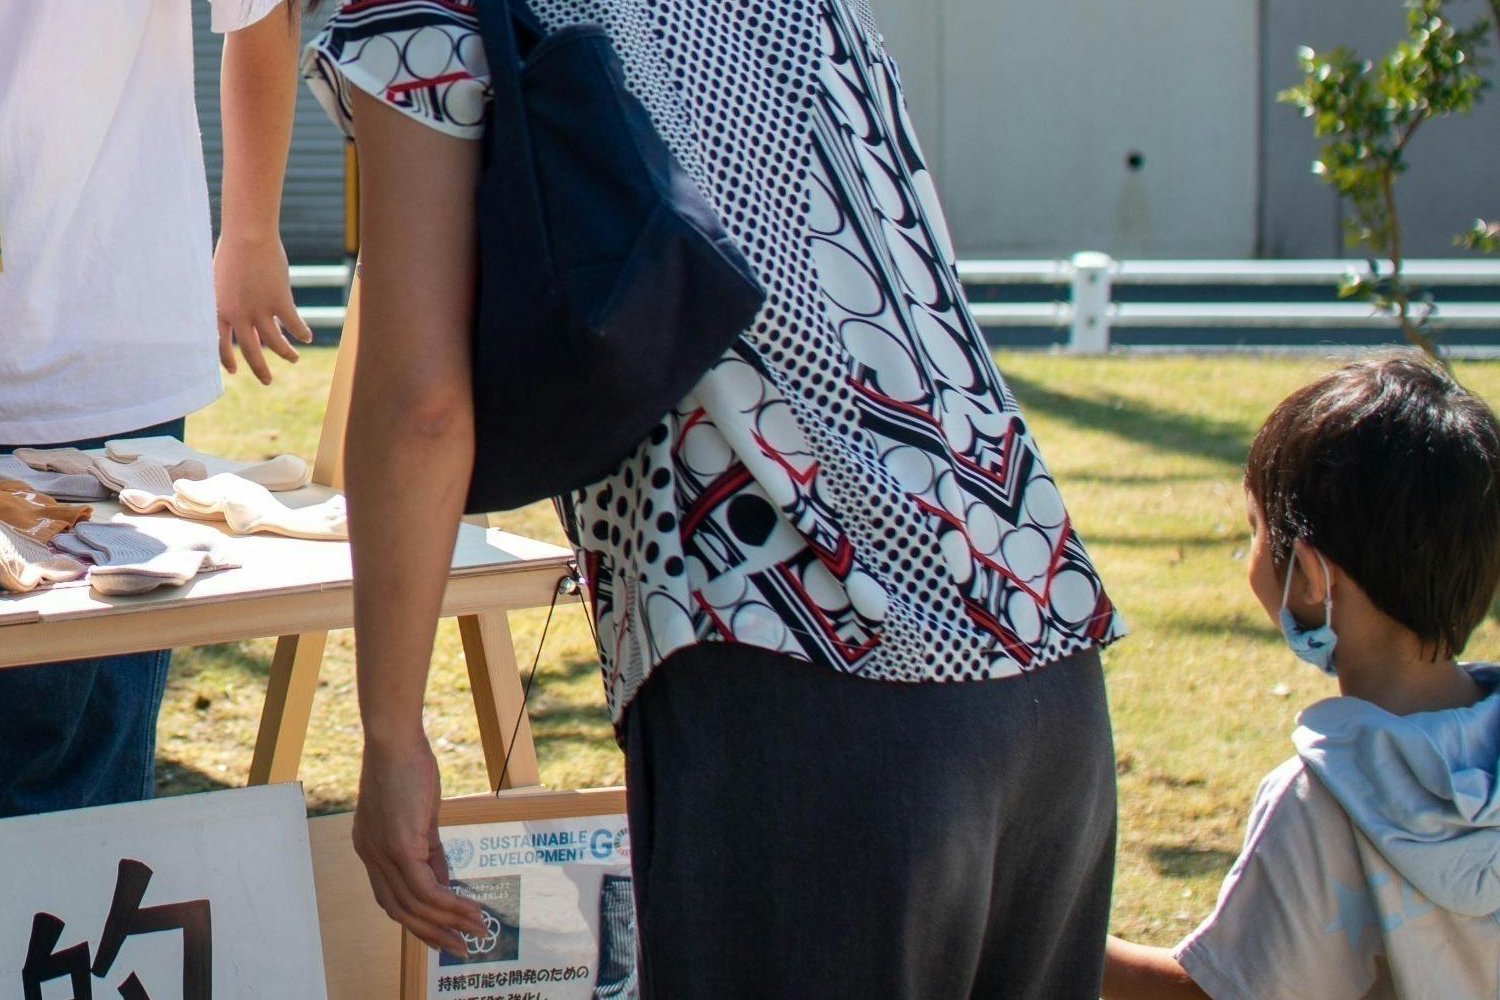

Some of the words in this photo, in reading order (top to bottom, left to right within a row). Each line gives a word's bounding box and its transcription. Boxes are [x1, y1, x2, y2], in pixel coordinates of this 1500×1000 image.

[479, 830, 588, 852] SUSTAINABLE
[479, 847, 586, 868] DEVELOPMENT
[438, 965, 590, 993] 持続可能な開発のための
